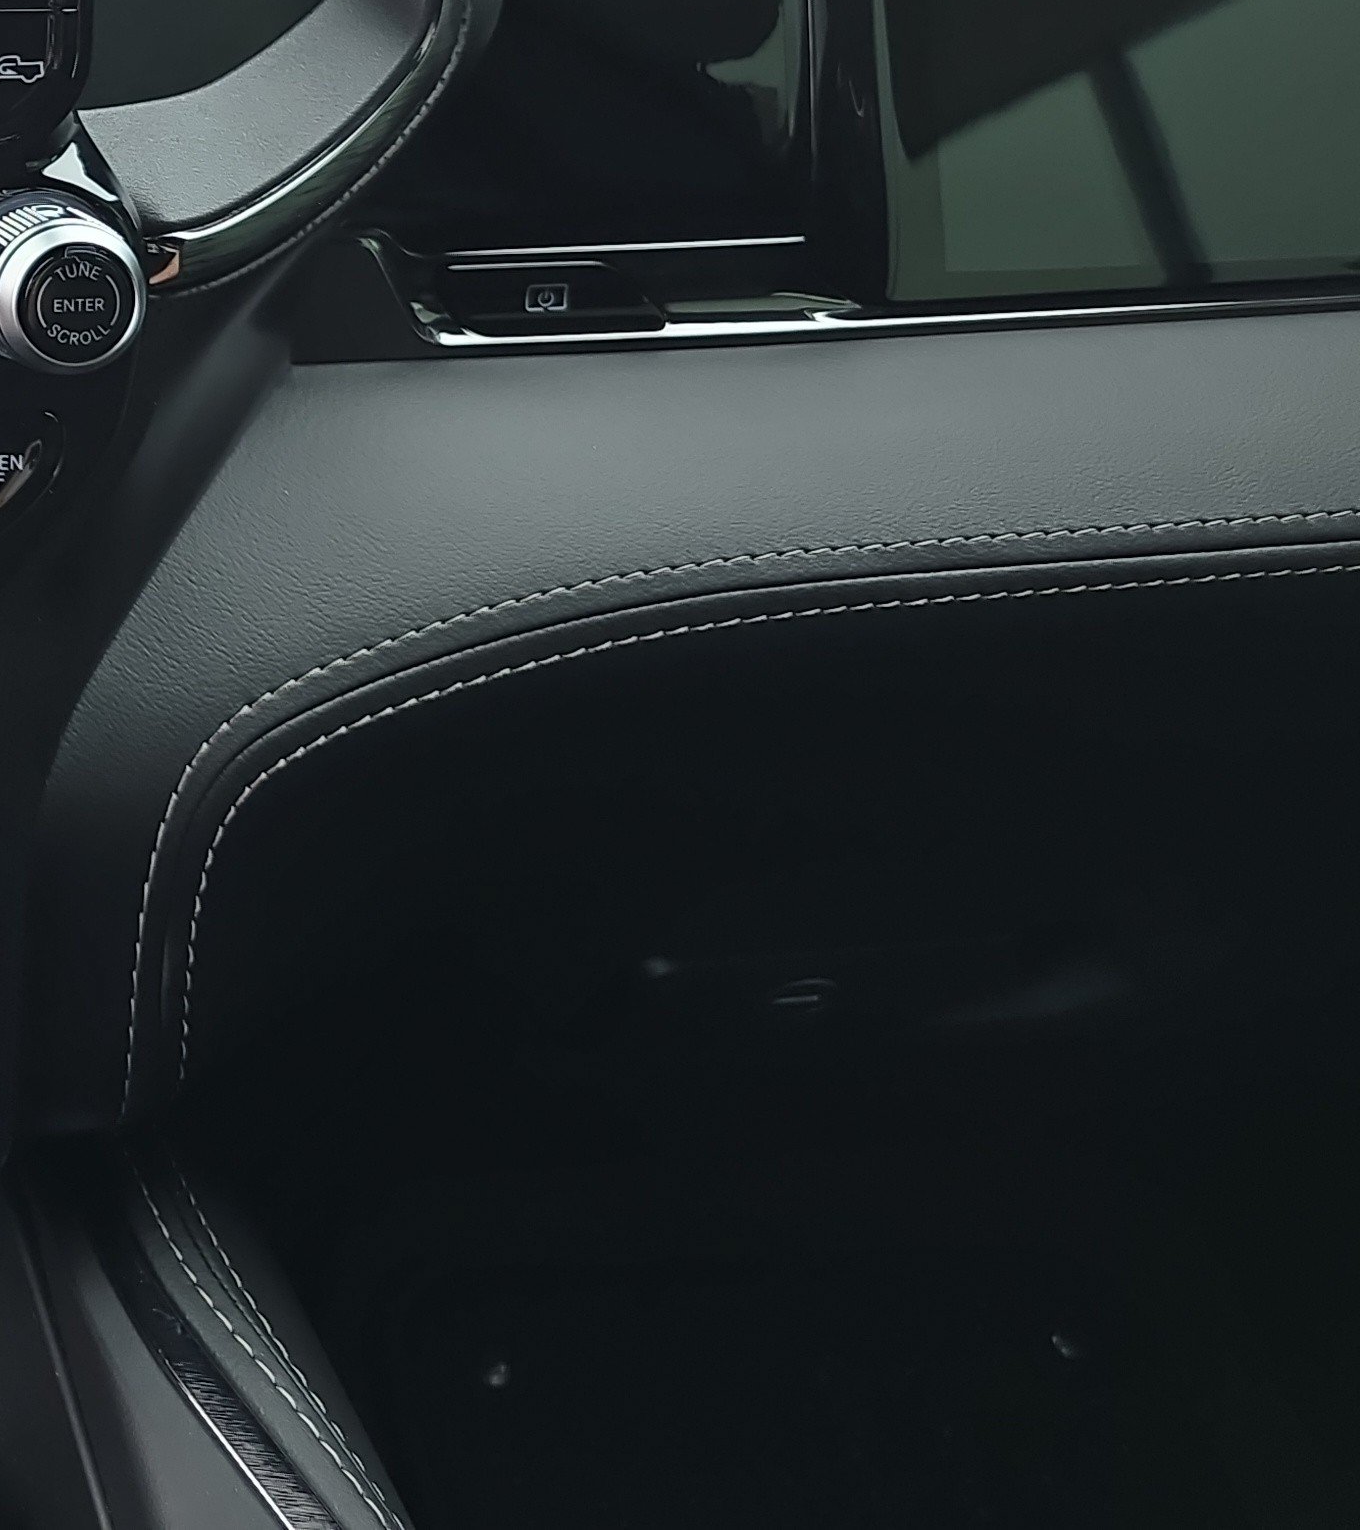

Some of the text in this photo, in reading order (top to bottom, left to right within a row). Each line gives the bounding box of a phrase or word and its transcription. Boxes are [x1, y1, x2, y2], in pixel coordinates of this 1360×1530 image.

[54, 262, 102, 282] TUNE
[53, 298, 105, 313] ENTER
[47, 323, 111, 346] SCROLL
